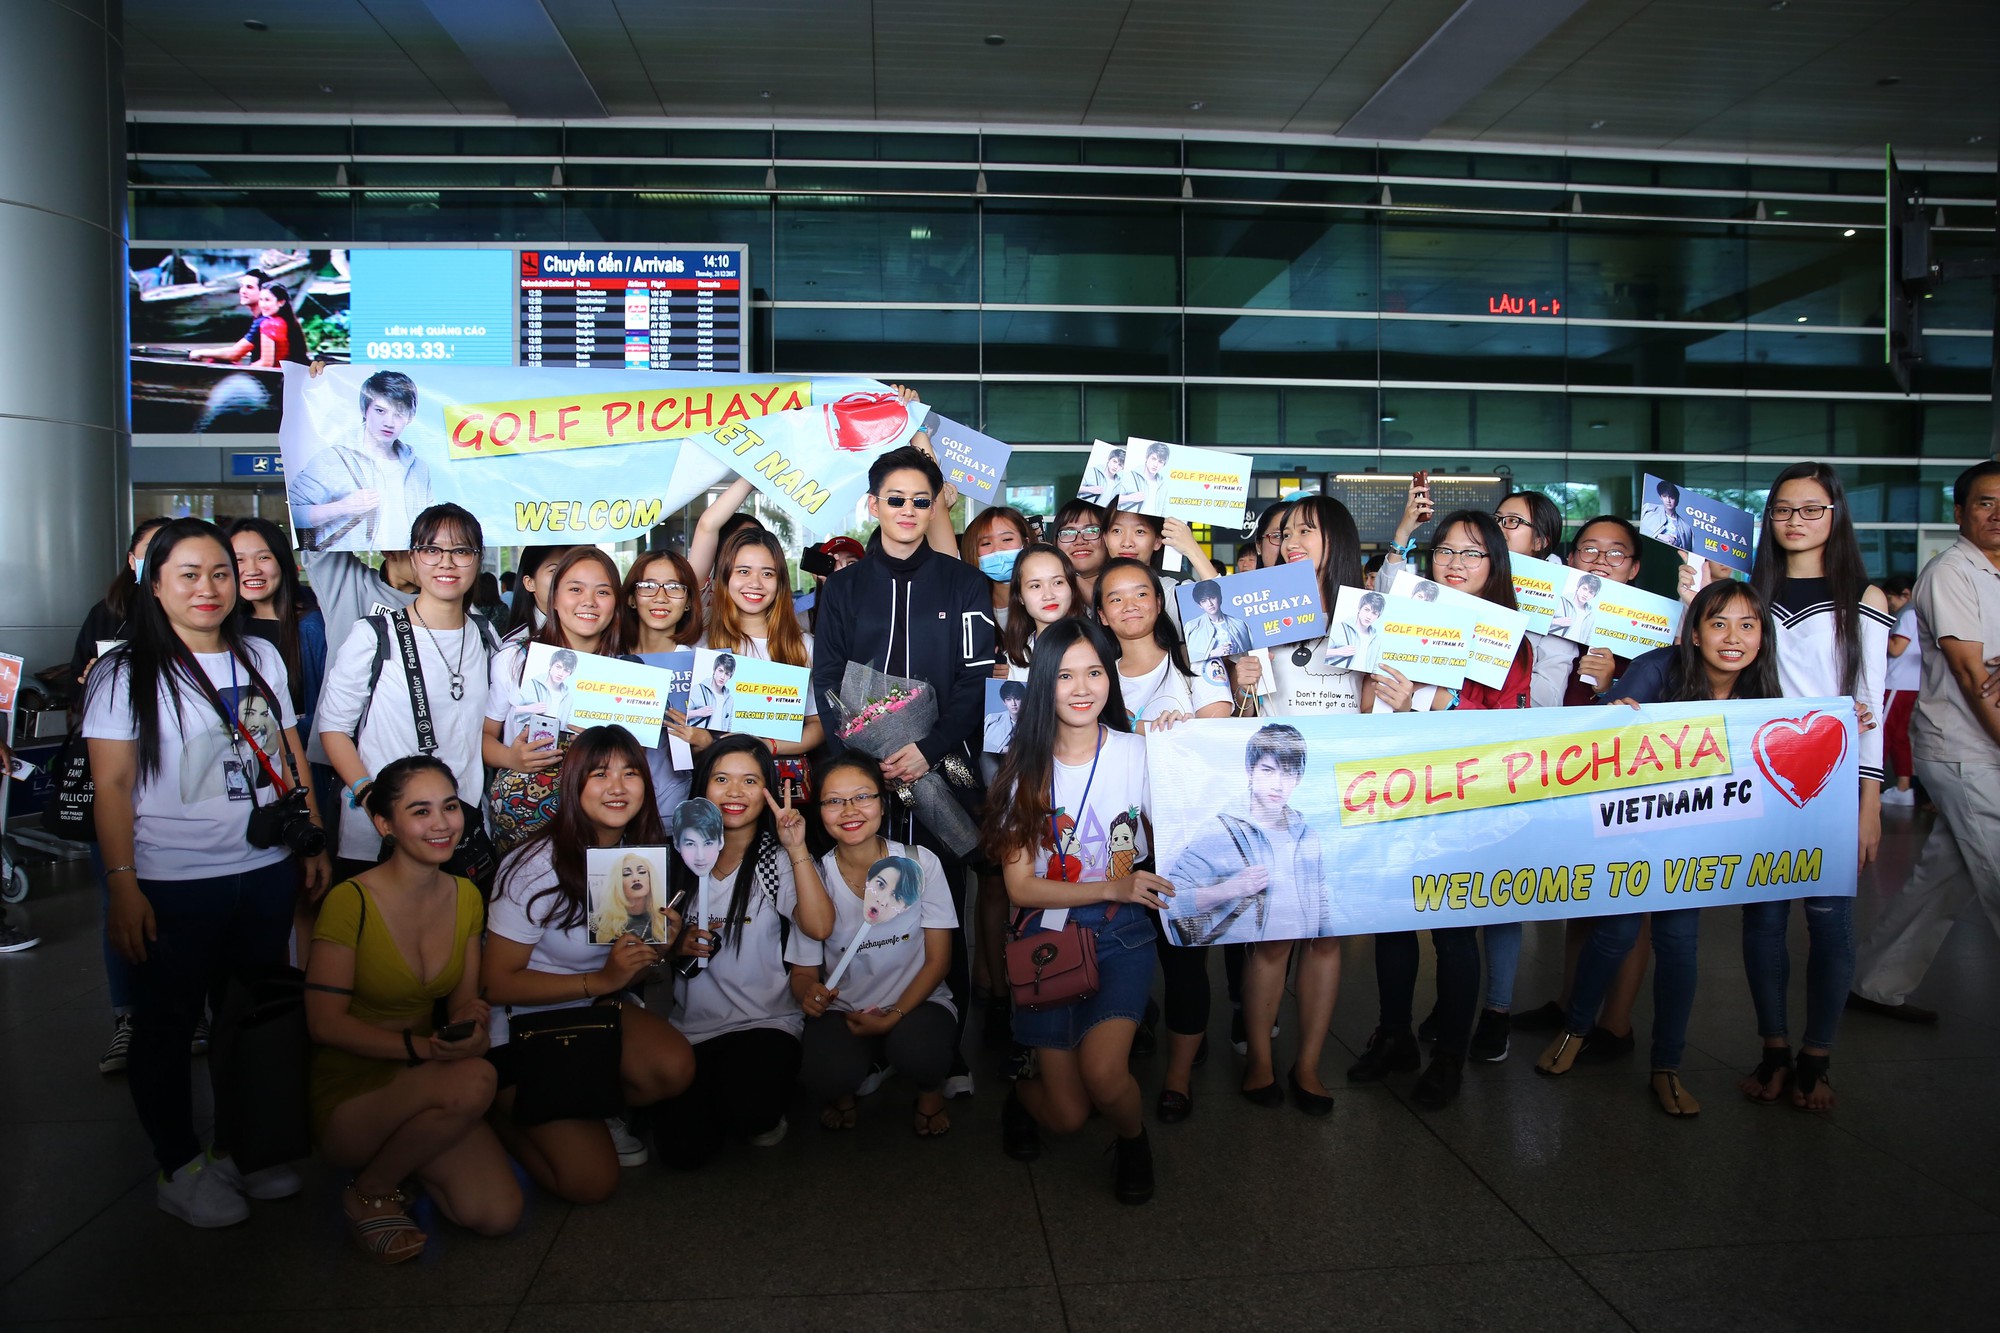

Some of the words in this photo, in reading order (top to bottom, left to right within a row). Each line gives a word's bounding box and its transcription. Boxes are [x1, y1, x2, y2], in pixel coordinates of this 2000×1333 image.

[633, 256, 684, 272] Arrivals
[703, 254, 729, 268] 14:10
[1528, 298, 1537, 314] 1
[385, 325, 408, 336] LIÊN
[464, 324, 486, 336] CÁO
[367, 342, 455, 359] 0933.33.
[452, 405, 581, 451] GOLF
[602, 386, 803, 437] PICHAYA
[941, 436, 972, 455] GOLF
[704, 422, 765, 457] ET
[754, 450, 831, 514] NAM
[944, 448, 996, 478] PICHAYA
[951, 468, 965, 478] WE
[976, 479, 992, 490] YOU
[1170, 472, 1196, 480] GOLF
[1199, 474, 1239, 483] PICHAYA
[1169, 497, 1202, 506] WELCOME
[1685, 506, 1718, 523] GOLF
[1693, 518, 1748, 546] PICHAYA
[1704, 538, 1718, 548] WE
[1732, 548, 1747, 559] YOU
[1511, 576, 1552, 592] PICHAYA
[1232, 589, 1270, 606] GOLF
[1524, 590, 1547, 598] VIETNAM
[1244, 594, 1312, 617] PICHAYA
[1522, 603, 1537, 613] VIET
[1536, 606, 1554, 616] NAM
[1598, 602, 1624, 615] GOLF
[1627, 610, 1668, 626] PICHAYA
[1264, 620, 1279, 631] WE
[1297, 613, 1315, 624] YOU
[1640, 623, 1665, 633] VIETNAM
[1384, 624, 1412, 633] GOLF
[1416, 627, 1460, 639] PICHAYA
[1594, 627, 1628, 640] WELCOME
[1629, 633, 1638, 642] TO
[1639, 636, 1655, 647] VIET
[1478, 637, 1503, 647] VIETNAM
[404, 634, 417, 669] Fashion
[1382, 652, 1418, 662] WELCOME
[1432, 656, 1448, 665] VIET
[1449, 659, 1467, 667] NAM
[1475, 652, 1492, 663] VIET
[1492, 658, 1511, 669] NAM
[413, 676, 426, 718] Soudelor
[577, 682, 605, 692] GOLF
[610, 686, 656, 698] PICHAYA
[736, 684, 759, 692] GOLF
[762, 686, 798, 695] PICHAYA
[575, 710, 612, 720] WELCOME
[614, 714, 624, 722] TO
[626, 715, 643, 723] VIET
[644, 717, 662, 725] NAM
[735, 711, 765, 719] WELCOME
[1343, 758, 1480, 815] GOLF
[1502, 724, 1726, 794] PICHAYA
[1600, 785, 1713, 827] VIETNAM
[1723, 779, 1752, 807] FC
[1412, 864, 1596, 912] WELCOME
[1607, 861, 1650, 898] TO
[1664, 854, 1742, 894] VIET
[1746, 848, 1822, 887] NAM
